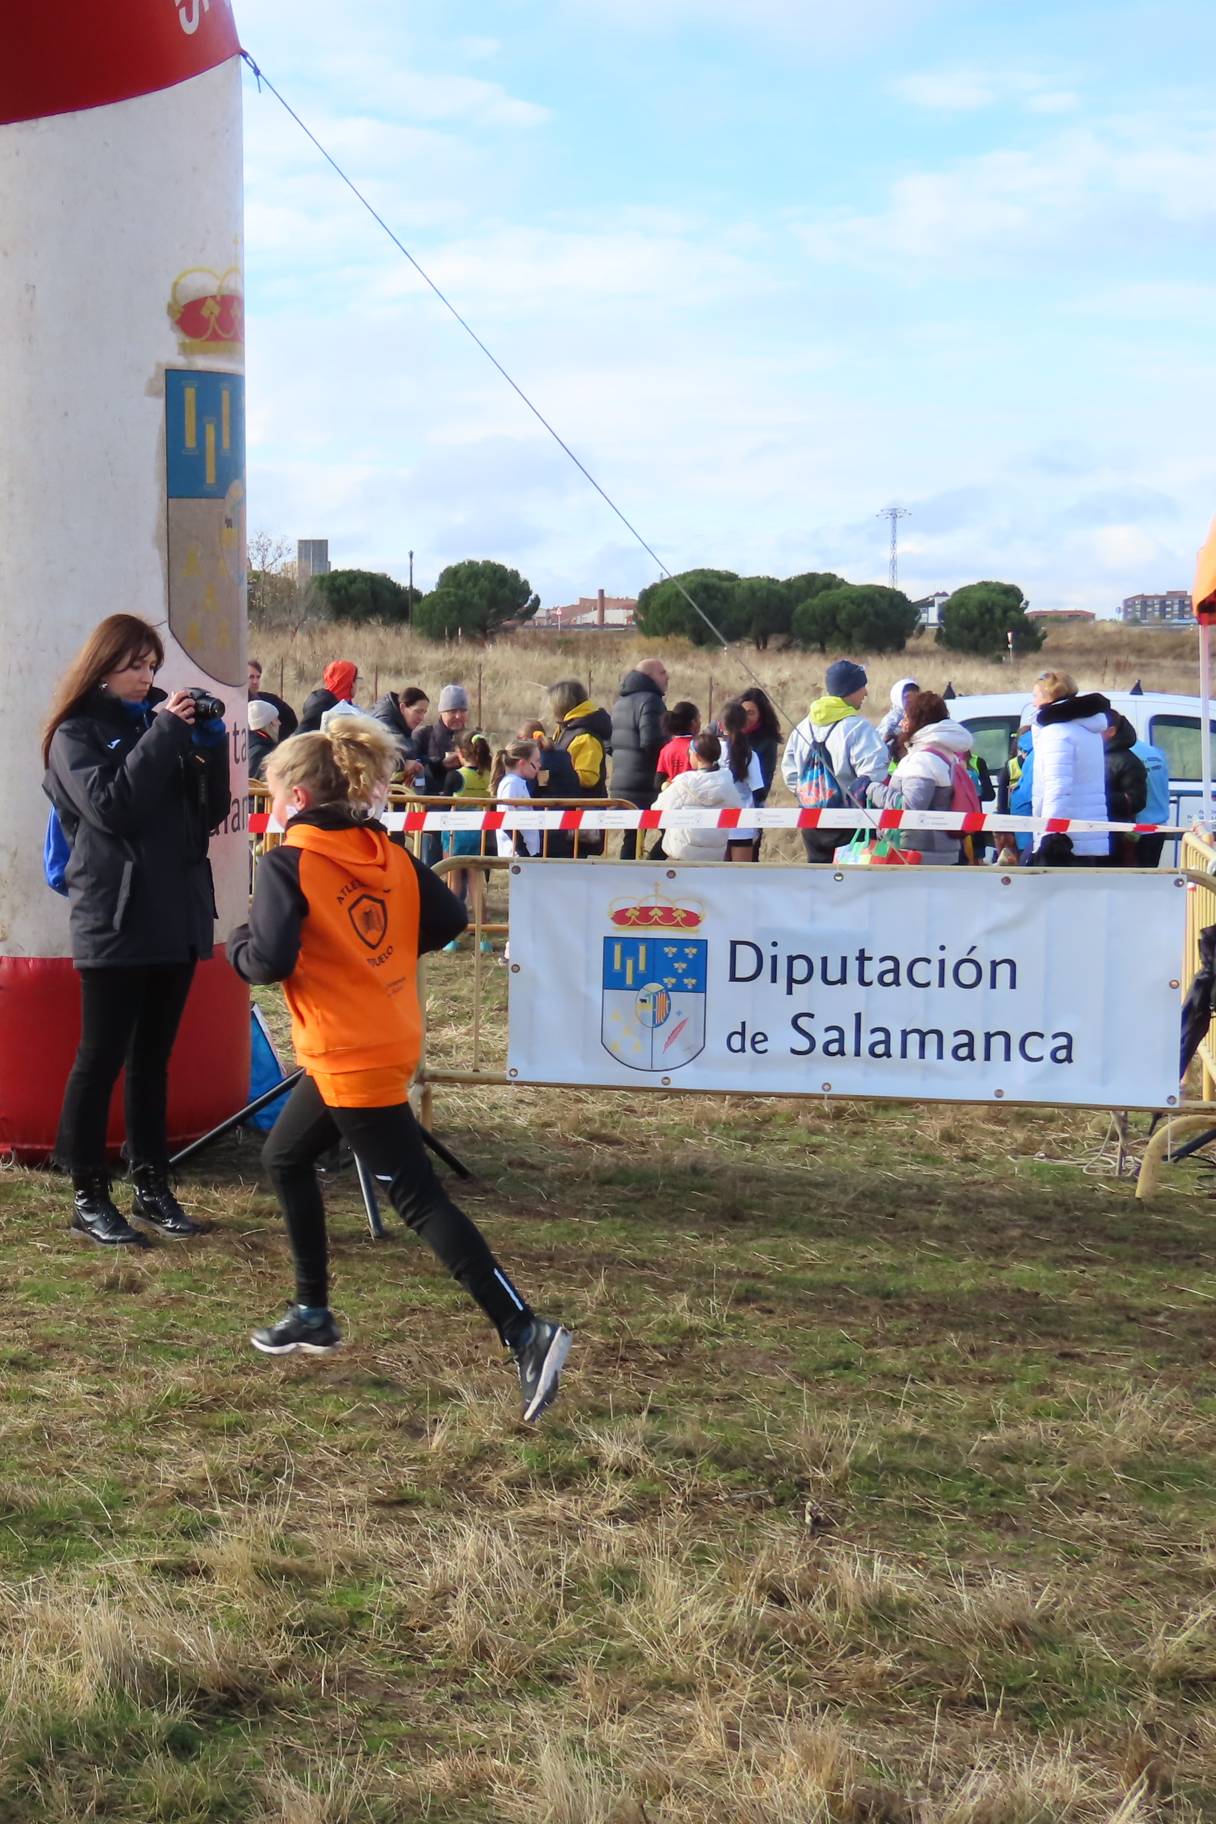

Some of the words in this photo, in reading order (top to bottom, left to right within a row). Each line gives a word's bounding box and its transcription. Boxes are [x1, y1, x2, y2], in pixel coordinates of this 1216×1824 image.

[728, 939, 1017, 996] Diputación
[726, 1021, 769, 1055] de
[789, 1011, 1074, 1065] Salamanca
